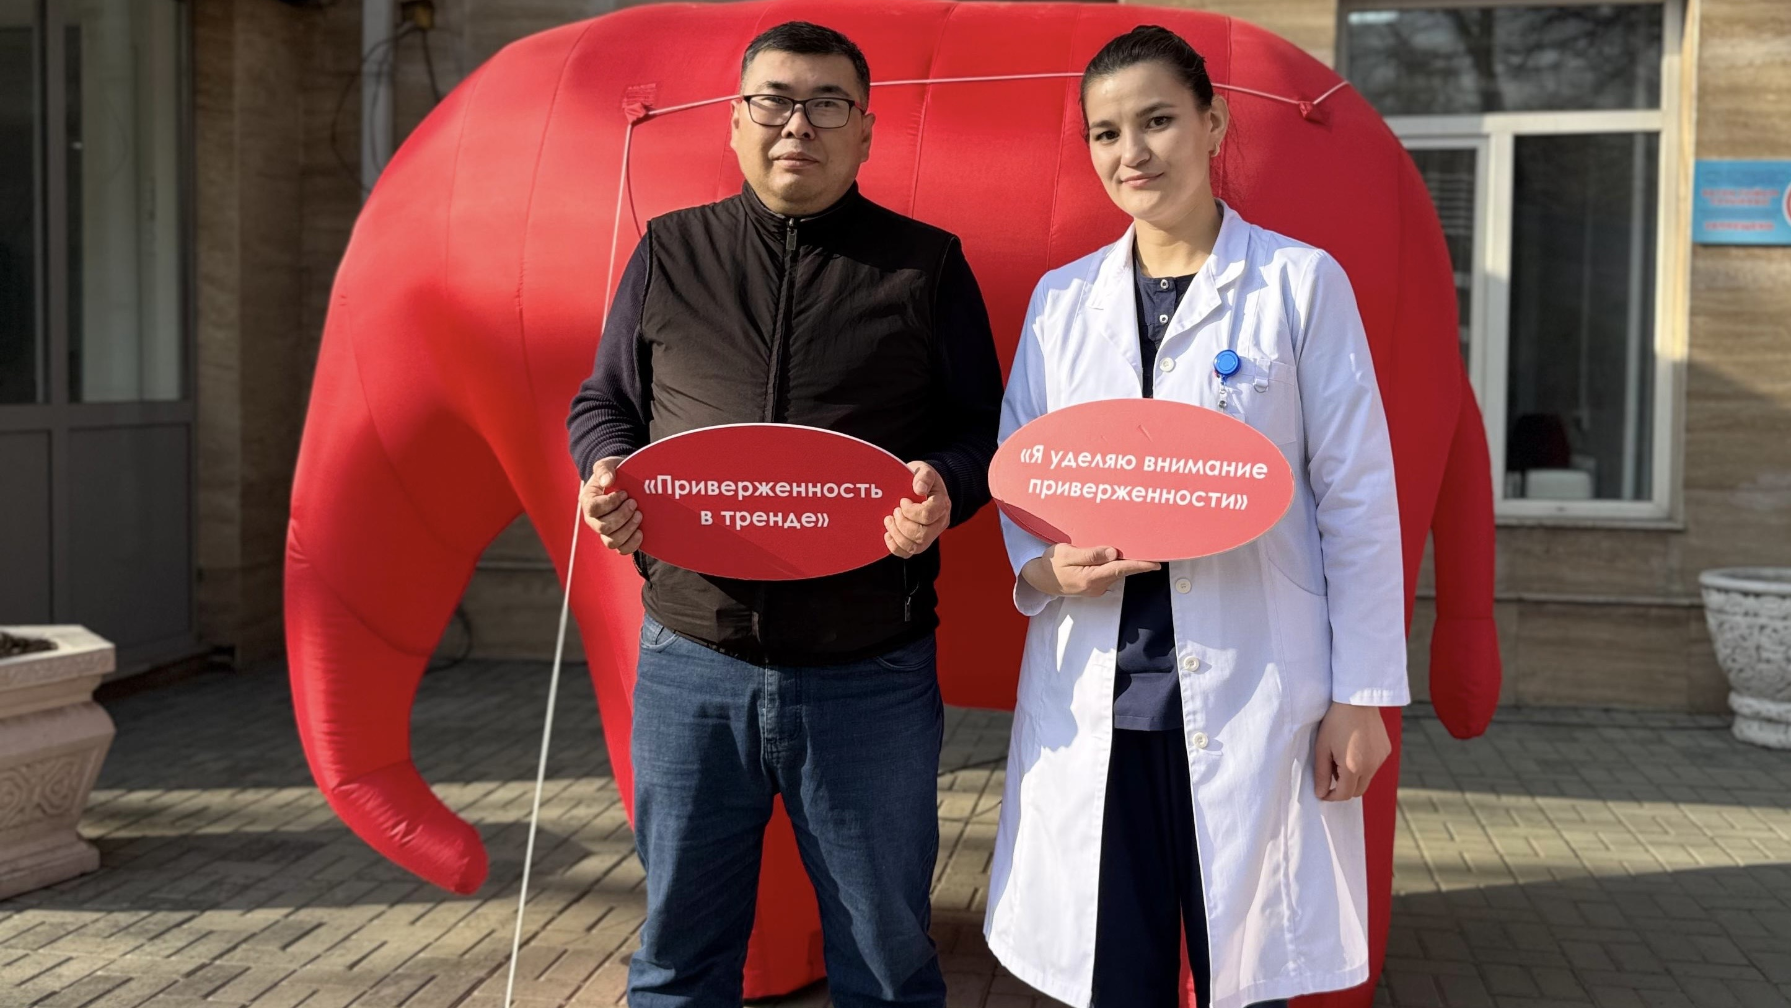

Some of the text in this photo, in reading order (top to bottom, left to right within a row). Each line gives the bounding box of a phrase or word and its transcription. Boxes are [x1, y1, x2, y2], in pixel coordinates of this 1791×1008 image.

[1021, 445, 1268, 479] «Я уделяю внимание
[644, 475, 883, 500] «Приверженность
[1028, 478, 1248, 510] приверженности»
[701, 511, 829, 530] в тренде»
